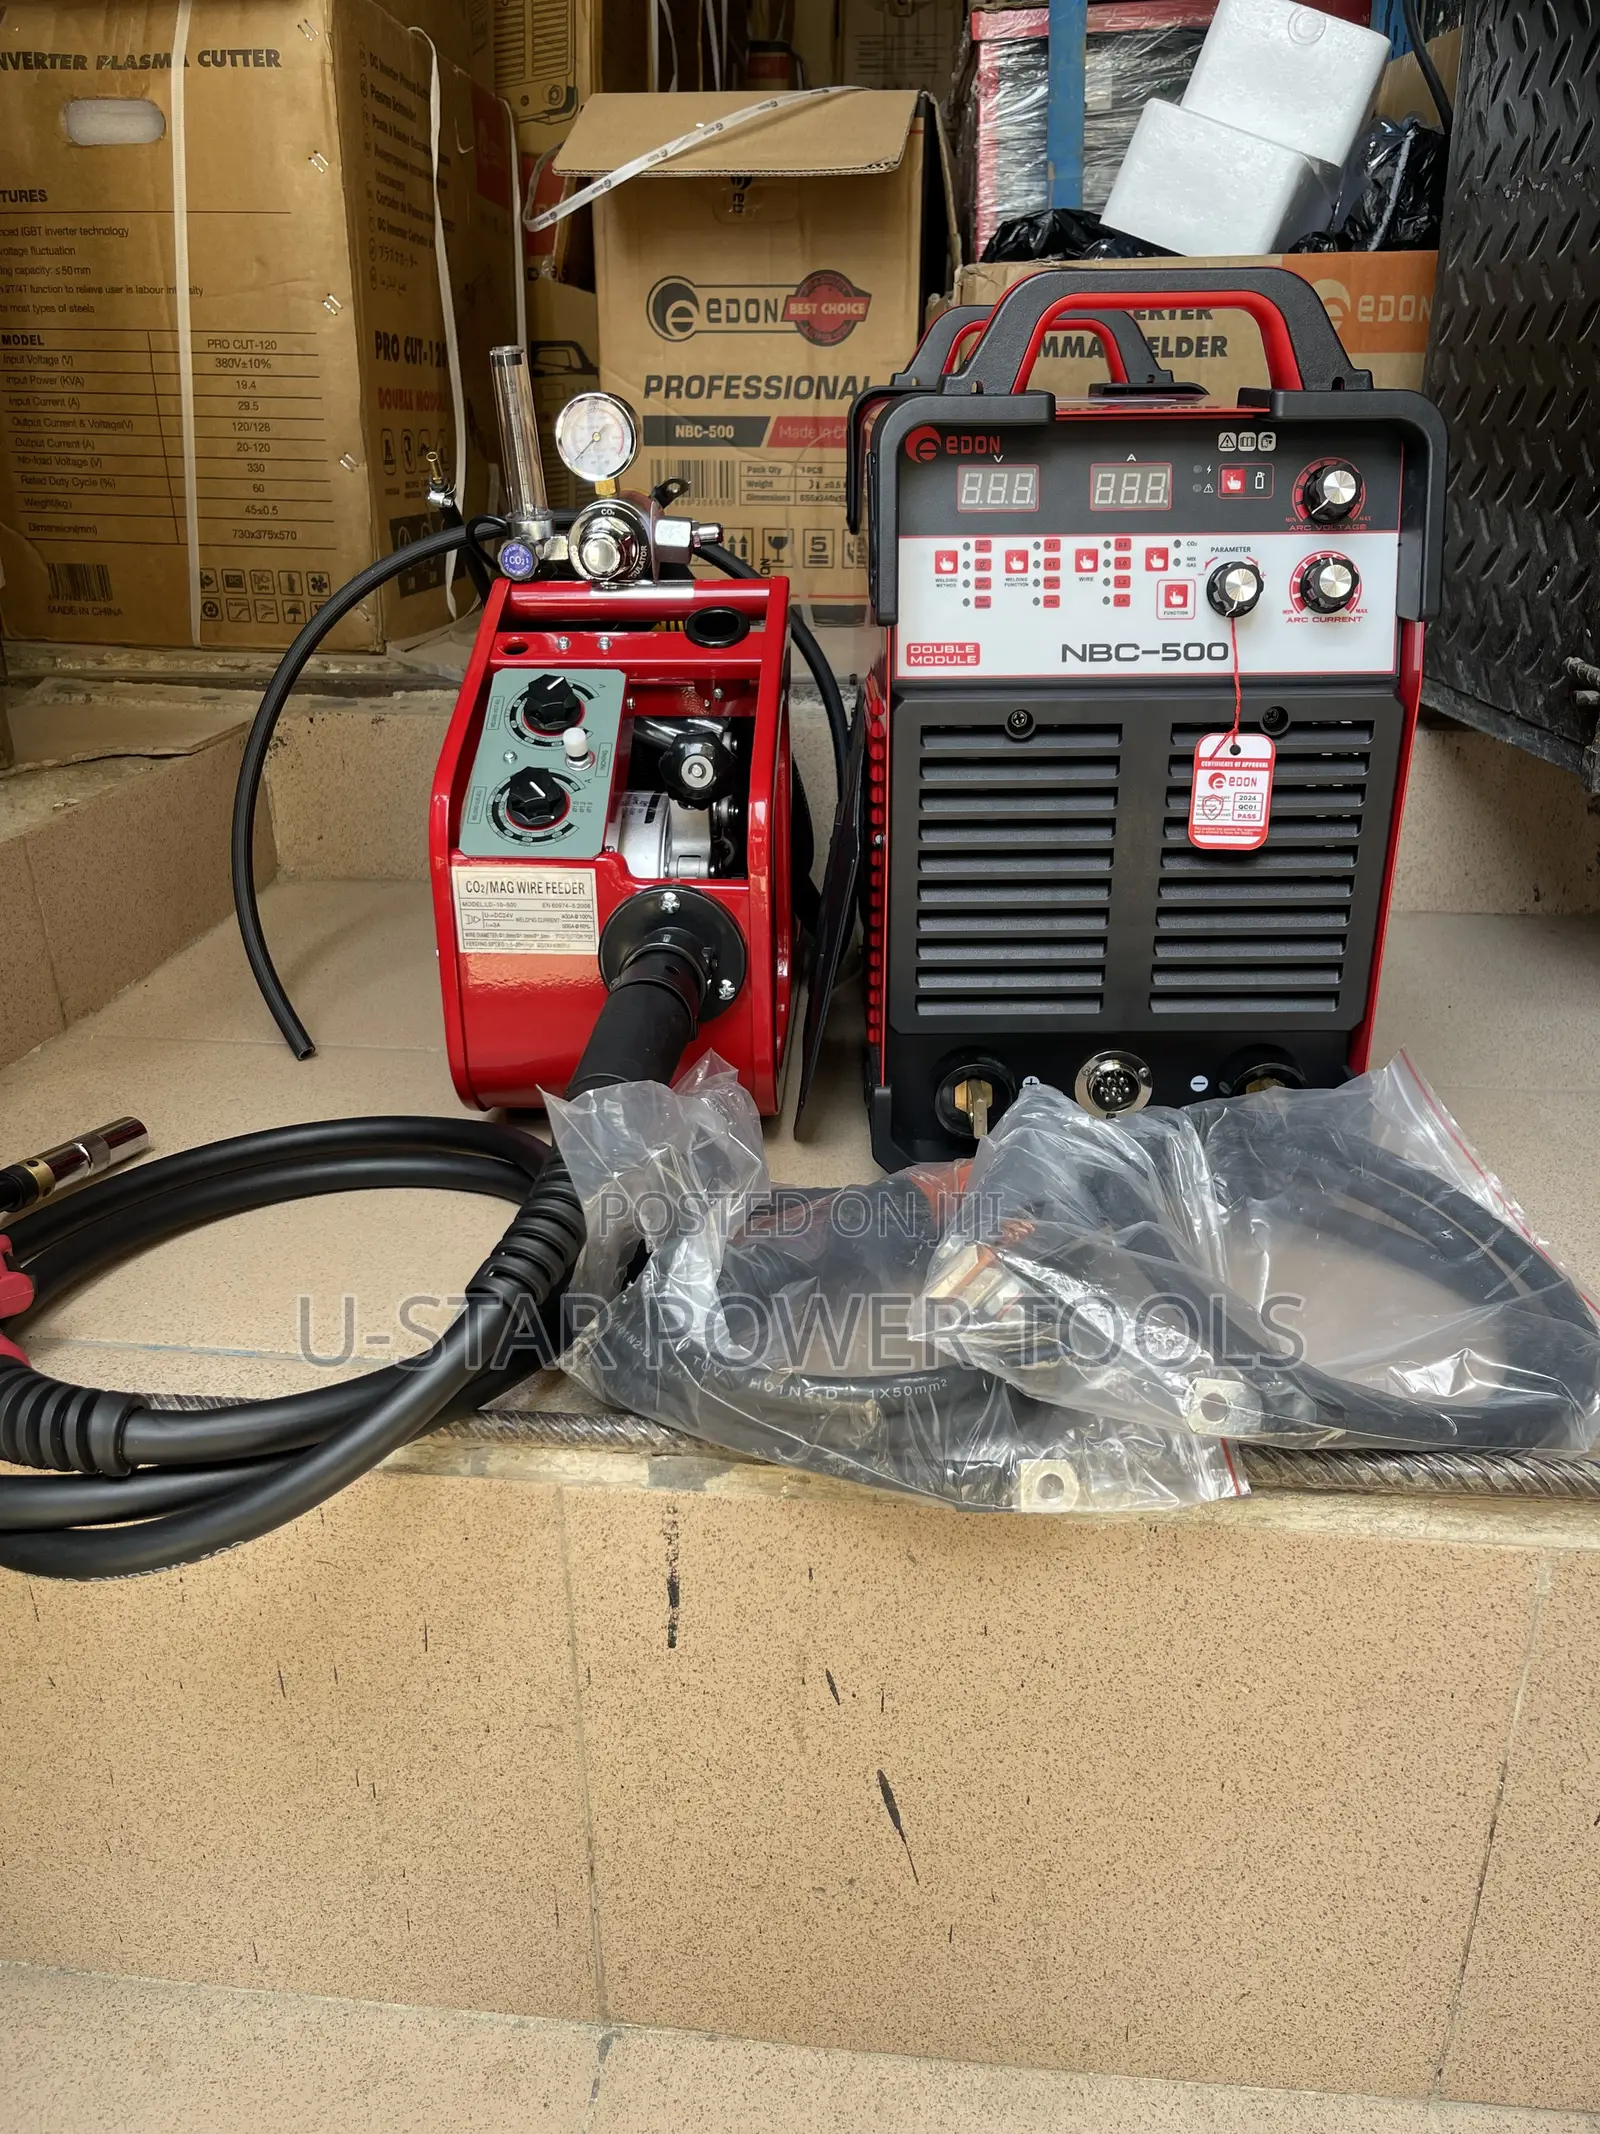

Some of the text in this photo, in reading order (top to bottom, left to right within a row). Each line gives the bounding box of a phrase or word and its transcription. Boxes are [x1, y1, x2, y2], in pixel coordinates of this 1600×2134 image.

[197, 49, 282, 68] CUTTER
[21, 227, 42, 237] IGBT
[45, 227, 78, 237] inverter
[80, 226, 130, 238] technology
[30, 246, 76, 257] fluctuation
[30, 285, 63, 294] function
[64, 286, 74, 294] to
[76, 285, 104, 295] relieve
[105, 287, 124, 295] user
[126, 286, 134, 295] is
[136, 285, 165, 295] labour
[167, 285, 204, 297] intsity
[33, 304, 56, 315] types
[58, 304, 67, 313] of
[69, 304, 95, 313] steels
[789, 303, 865, 315] BEST CHOICE
[1, 335, 45, 346] MODEL
[207, 339, 277, 350] PRO CUT-120
[374, 330, 401, 364] PRO
[1146, 335, 1228, 358] ELDER
[3, 355, 74, 367] Input Voltage (V)
[215, 358, 271, 369] 380V±10%
[6, 375, 28, 386] Input
[30, 376, 58, 386] Power
[9, 397, 31, 408] Input
[33, 397, 67, 407] Current
[238, 401, 259, 411] 29.5
[44, 418, 77, 428] Current
[675, 425, 735, 439] NBC-500
[779, 425, 814, 438] Made
[47, 438, 80, 449] Current
[237, 442, 270, 453] 20-120
[54, 457, 88, 468] Voltage
[993, 455, 1004, 463] V
[1126, 454, 1137, 462] A
[247, 463, 265, 473] 330
[49, 477, 69, 488] Duty
[252, 483, 265, 493] 60
[1288, 523, 1367, 531] ARC VOLTAGE
[629, 545, 648, 579] GULATOR
[47, 605, 125, 617] MADE IN CHINA
[1285, 616, 1309, 624] ARC
[910, 645, 975, 654] DOUBLE
[1061, 641, 1229, 664] NBC-500
[910, 655, 977, 665] MODULE
[518, 881, 543, 895] WIRE
[546, 882, 585, 896] FEEDER
